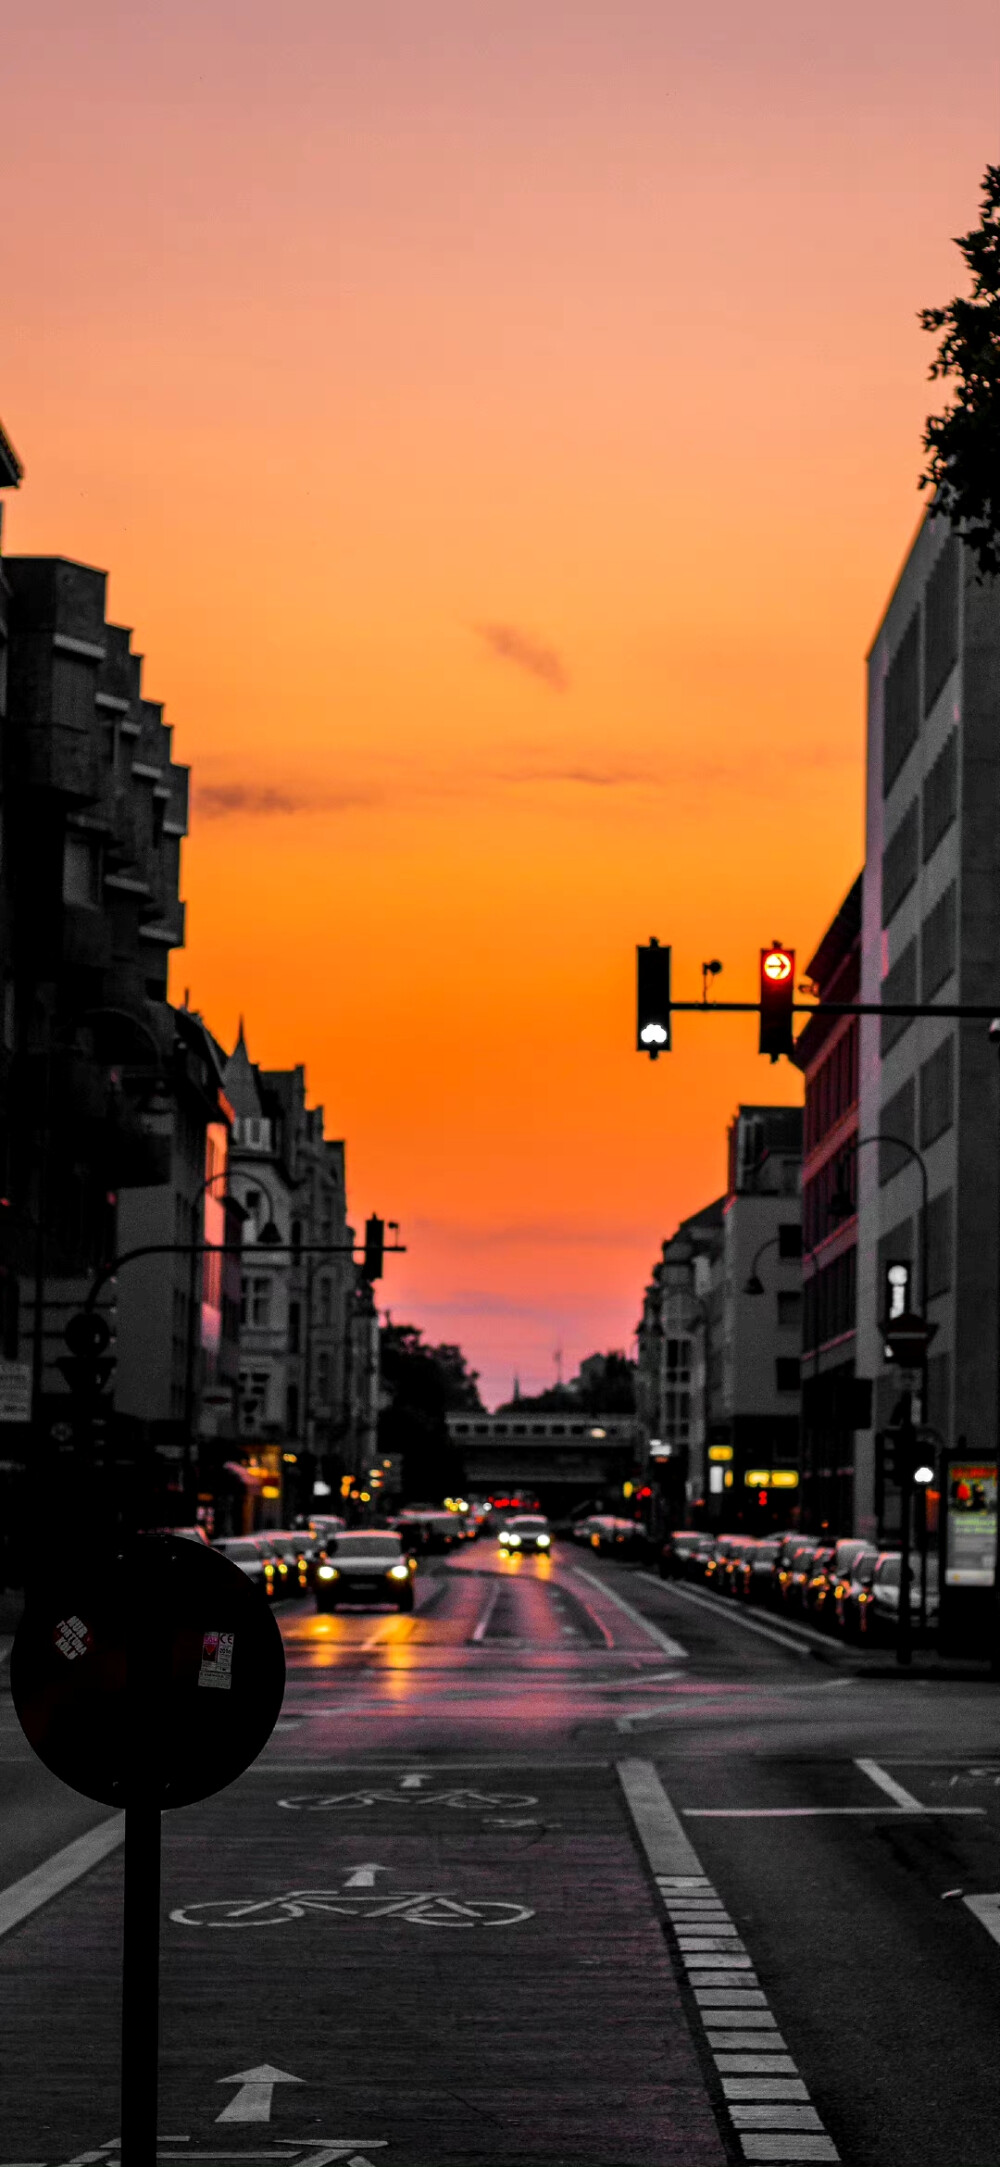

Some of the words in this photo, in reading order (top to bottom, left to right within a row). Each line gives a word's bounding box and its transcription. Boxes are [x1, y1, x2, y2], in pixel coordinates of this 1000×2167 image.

[56, 1619, 88, 1656] FORTUNA
[66, 1615, 88, 1639] NUR
[220, 1634, 233, 1645] CE
